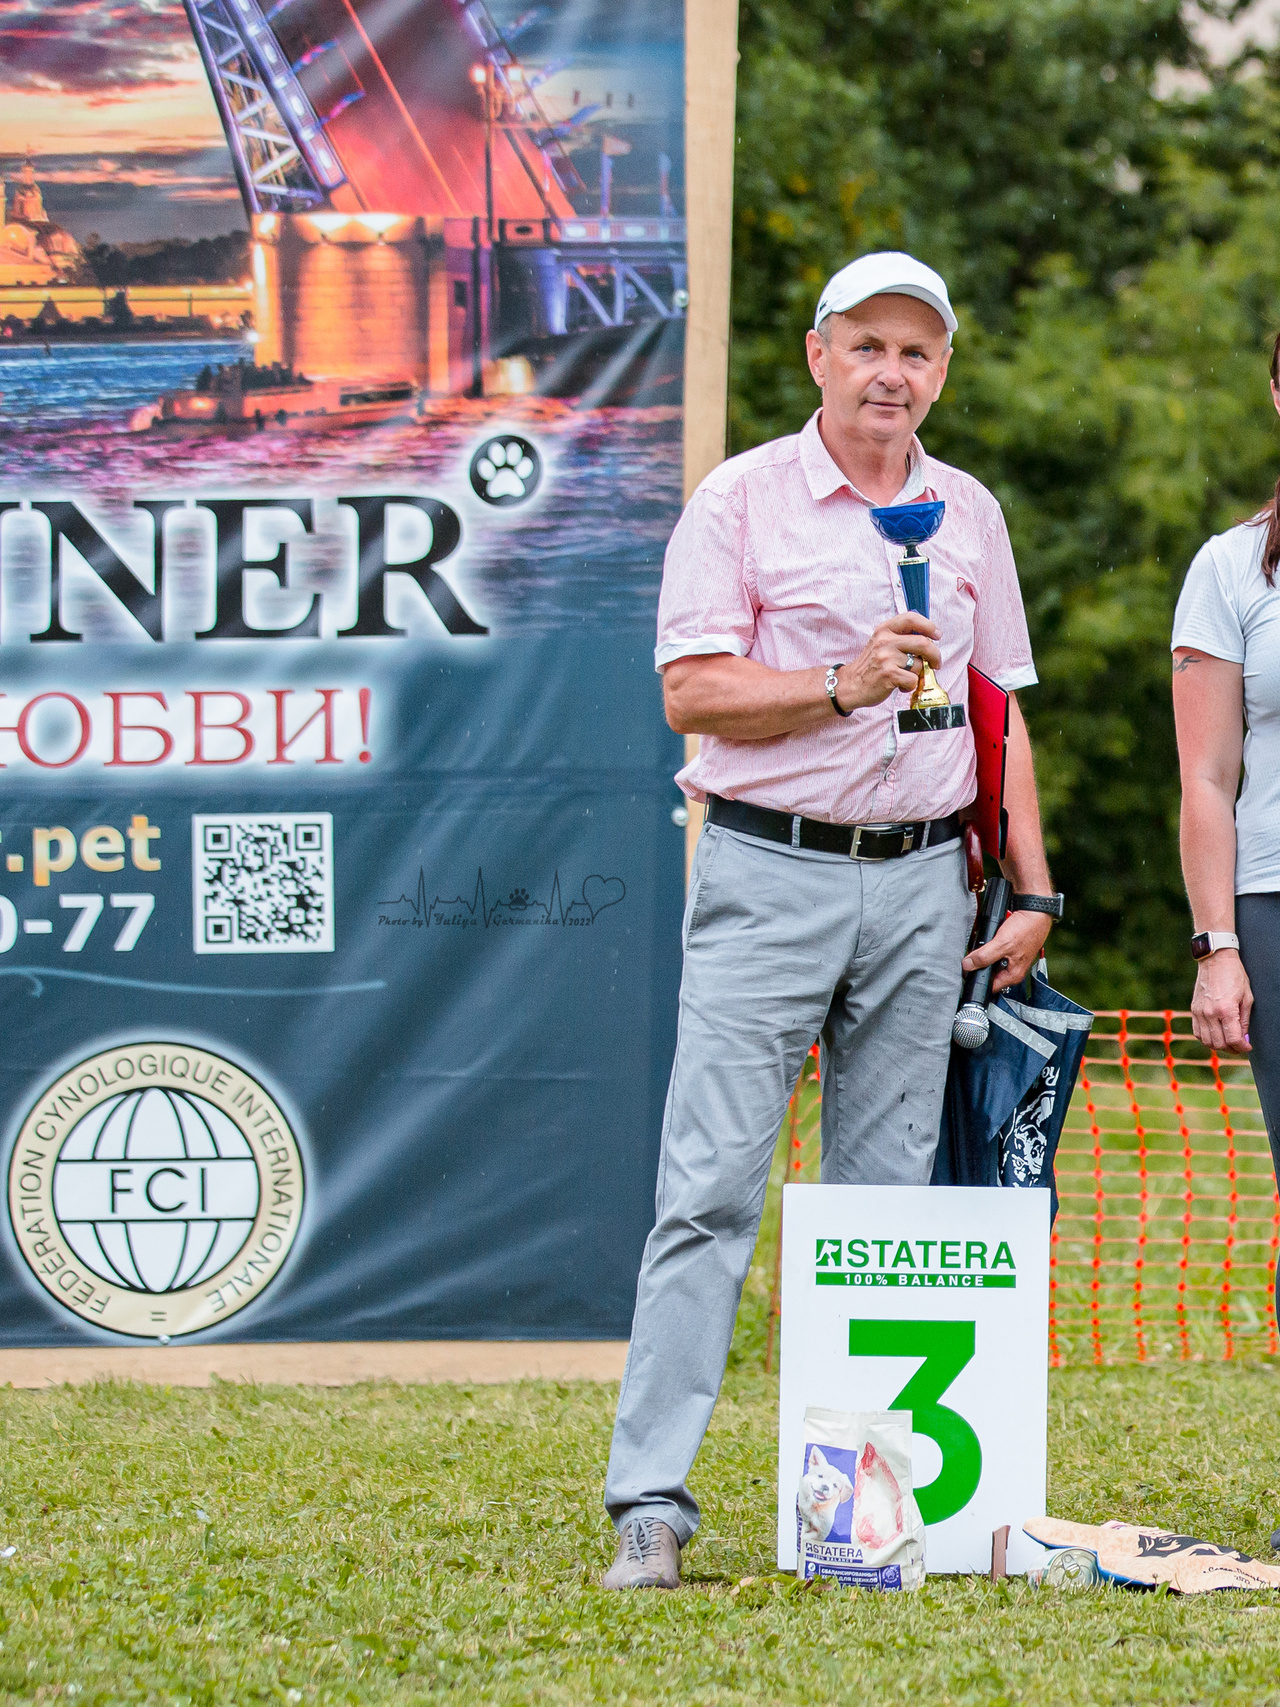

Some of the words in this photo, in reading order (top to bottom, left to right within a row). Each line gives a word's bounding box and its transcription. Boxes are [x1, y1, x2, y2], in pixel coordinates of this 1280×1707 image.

[0, 495, 490, 643] NER
[0, 815, 161, 886] .pet
[35, 1053, 234, 1142] CYNOLOGIQUE
[205, 1085, 295, 1314] INTERNATIONALE
[110, 1167, 207, 1213] FCI
[844, 1273, 888, 1286] 100%
[898, 1274, 984, 1287] BALANCE
[846, 1238, 1017, 1270] STATERA
[848, 1318, 983, 1527] 3
[813, 1543, 864, 1559] STATERA
